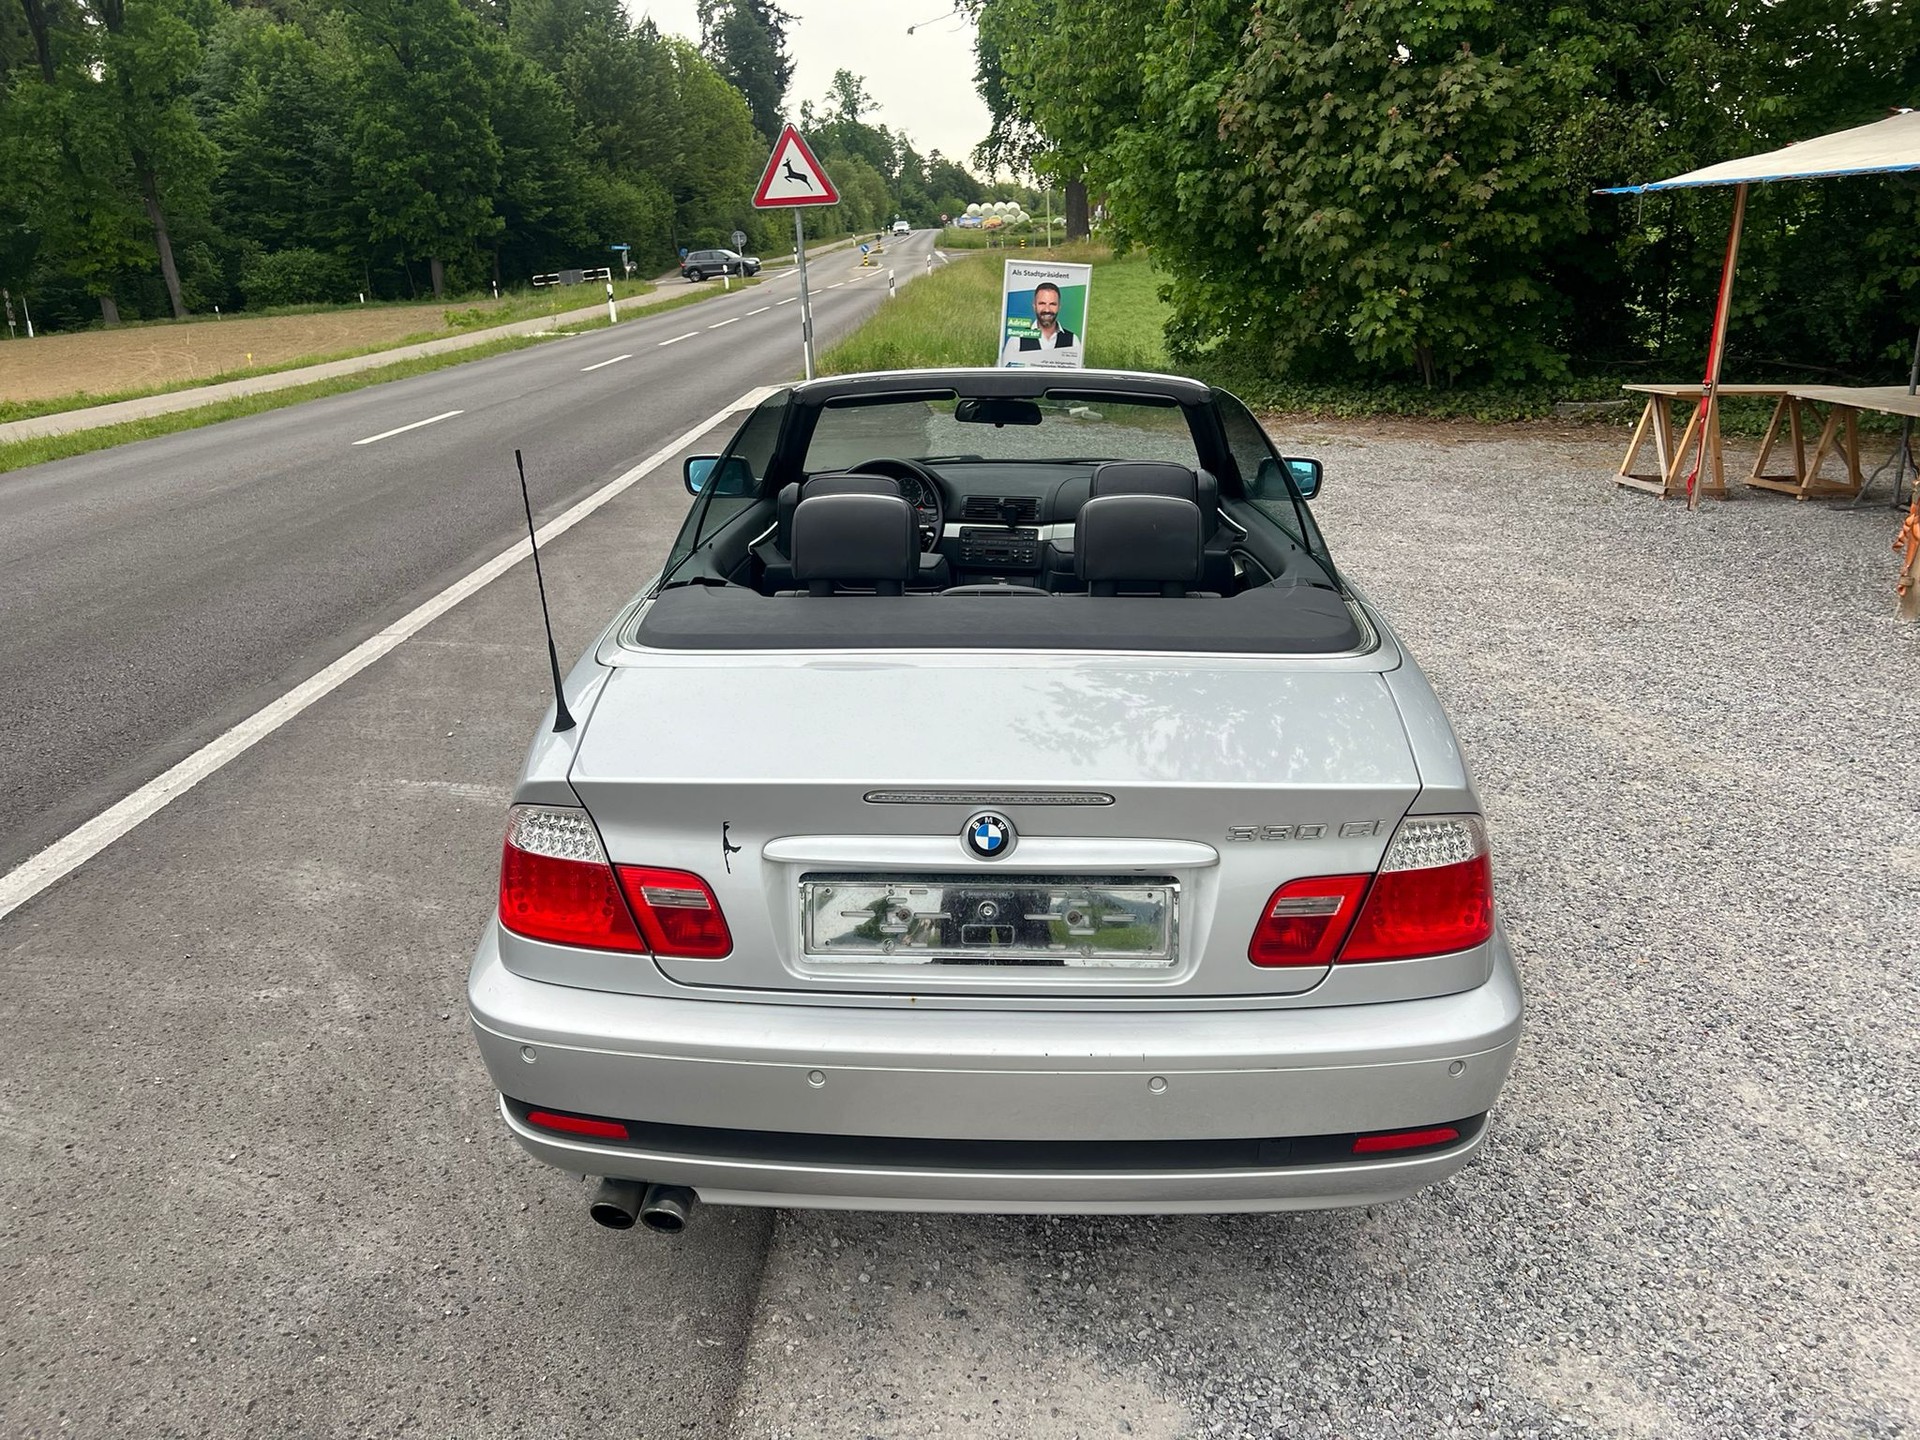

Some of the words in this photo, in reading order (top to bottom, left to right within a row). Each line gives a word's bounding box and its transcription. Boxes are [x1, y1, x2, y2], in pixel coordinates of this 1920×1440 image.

[1023, 269, 1070, 279] Stadtpräsident
[1008, 318, 1031, 327] Adrian
[1007, 328, 1041, 337] Bangerter
[971, 816, 1007, 831] BMW
[1225, 823, 1329, 843] 330
